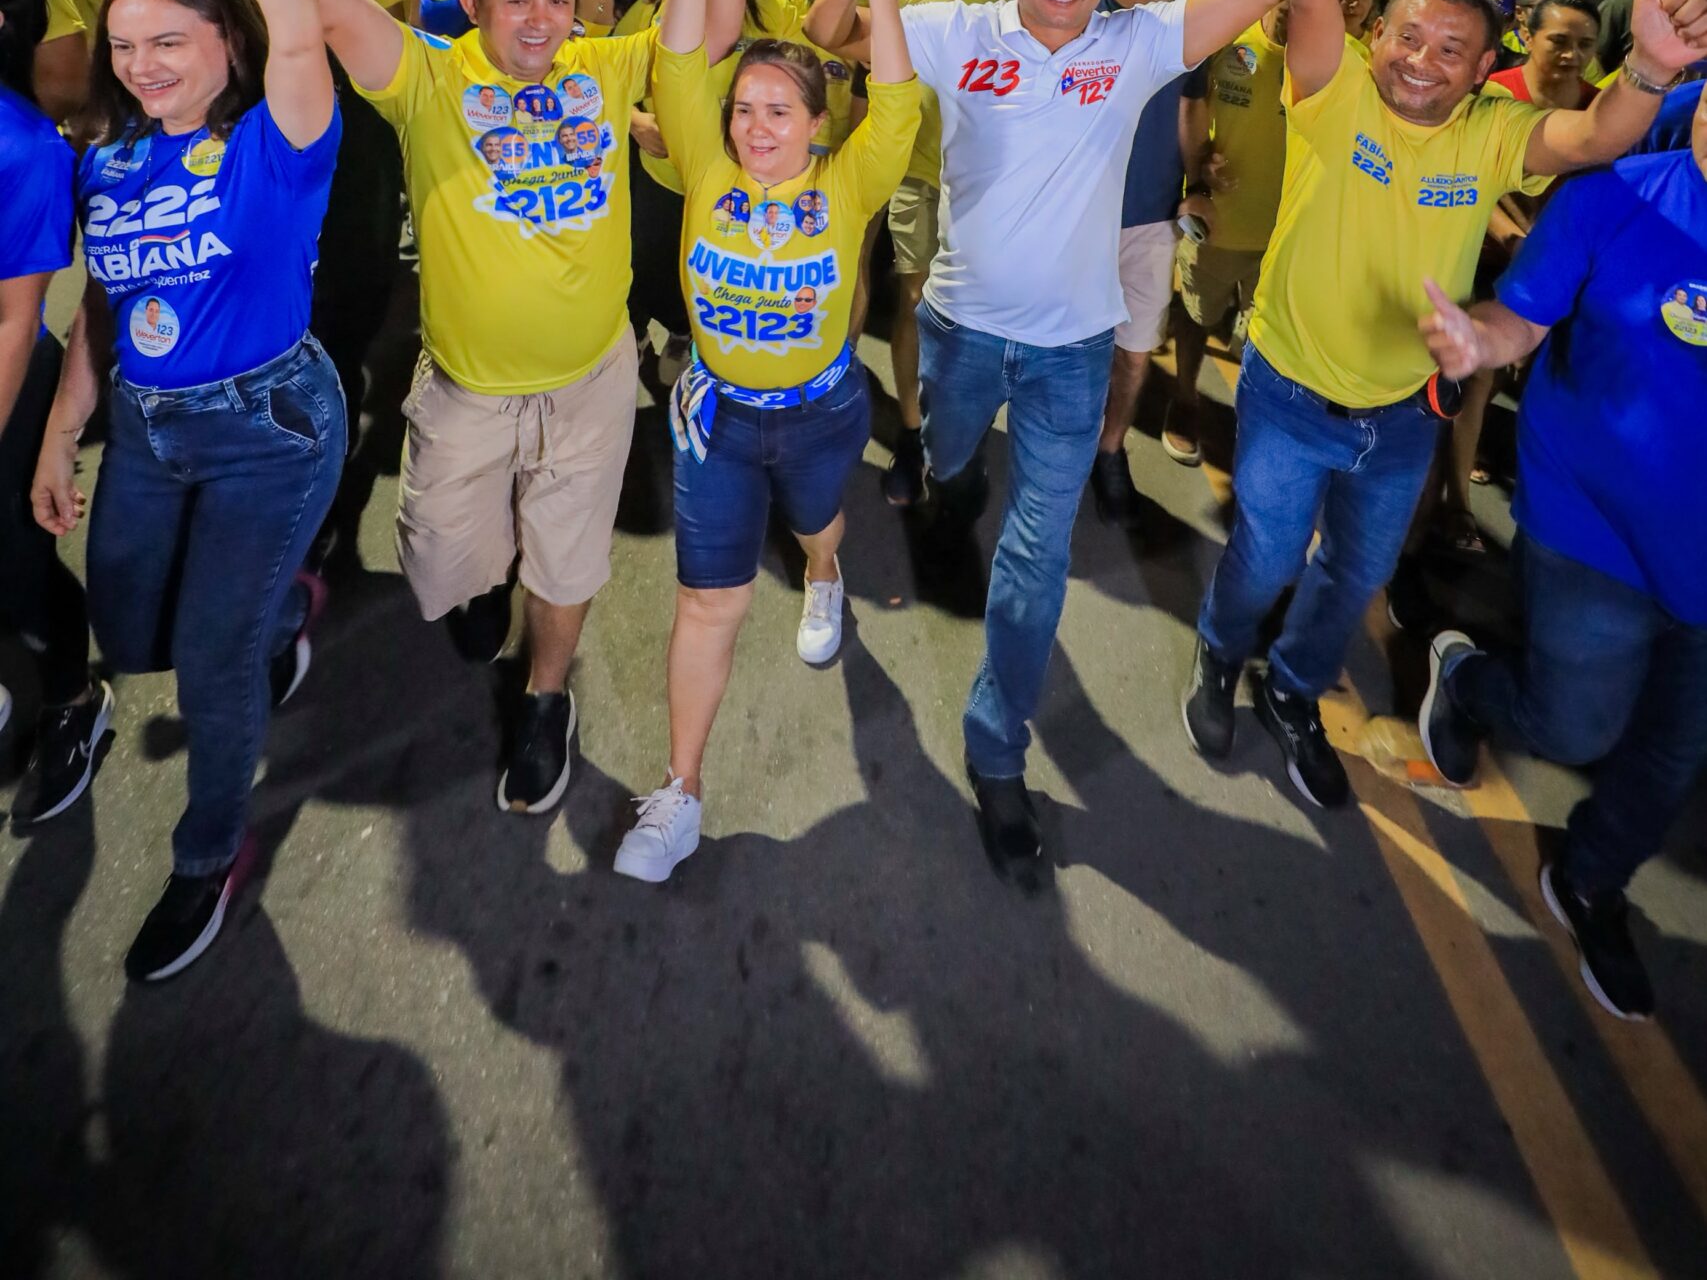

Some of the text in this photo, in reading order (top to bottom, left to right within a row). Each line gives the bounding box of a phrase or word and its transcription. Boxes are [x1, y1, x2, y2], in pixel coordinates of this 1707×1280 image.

[957, 58, 1020, 96] 123
[582, 86, 598, 99] 123
[467, 109, 508, 122] Weverton
[492, 105, 509, 115] 123
[576, 129, 597, 146] 55
[501, 142, 526, 158] 55
[549, 168, 585, 183] Junto
[1417, 188, 1478, 208] 22123
[88, 243, 126, 256] FEDERAL
[88, 231, 233, 282] ABIANA
[688, 242, 836, 293] JUVENTUDE
[188, 269, 211, 283] faz
[713, 286, 792, 309] Chega Junto
[695, 296, 814, 341] 22123
[157, 323, 174, 336] 123
